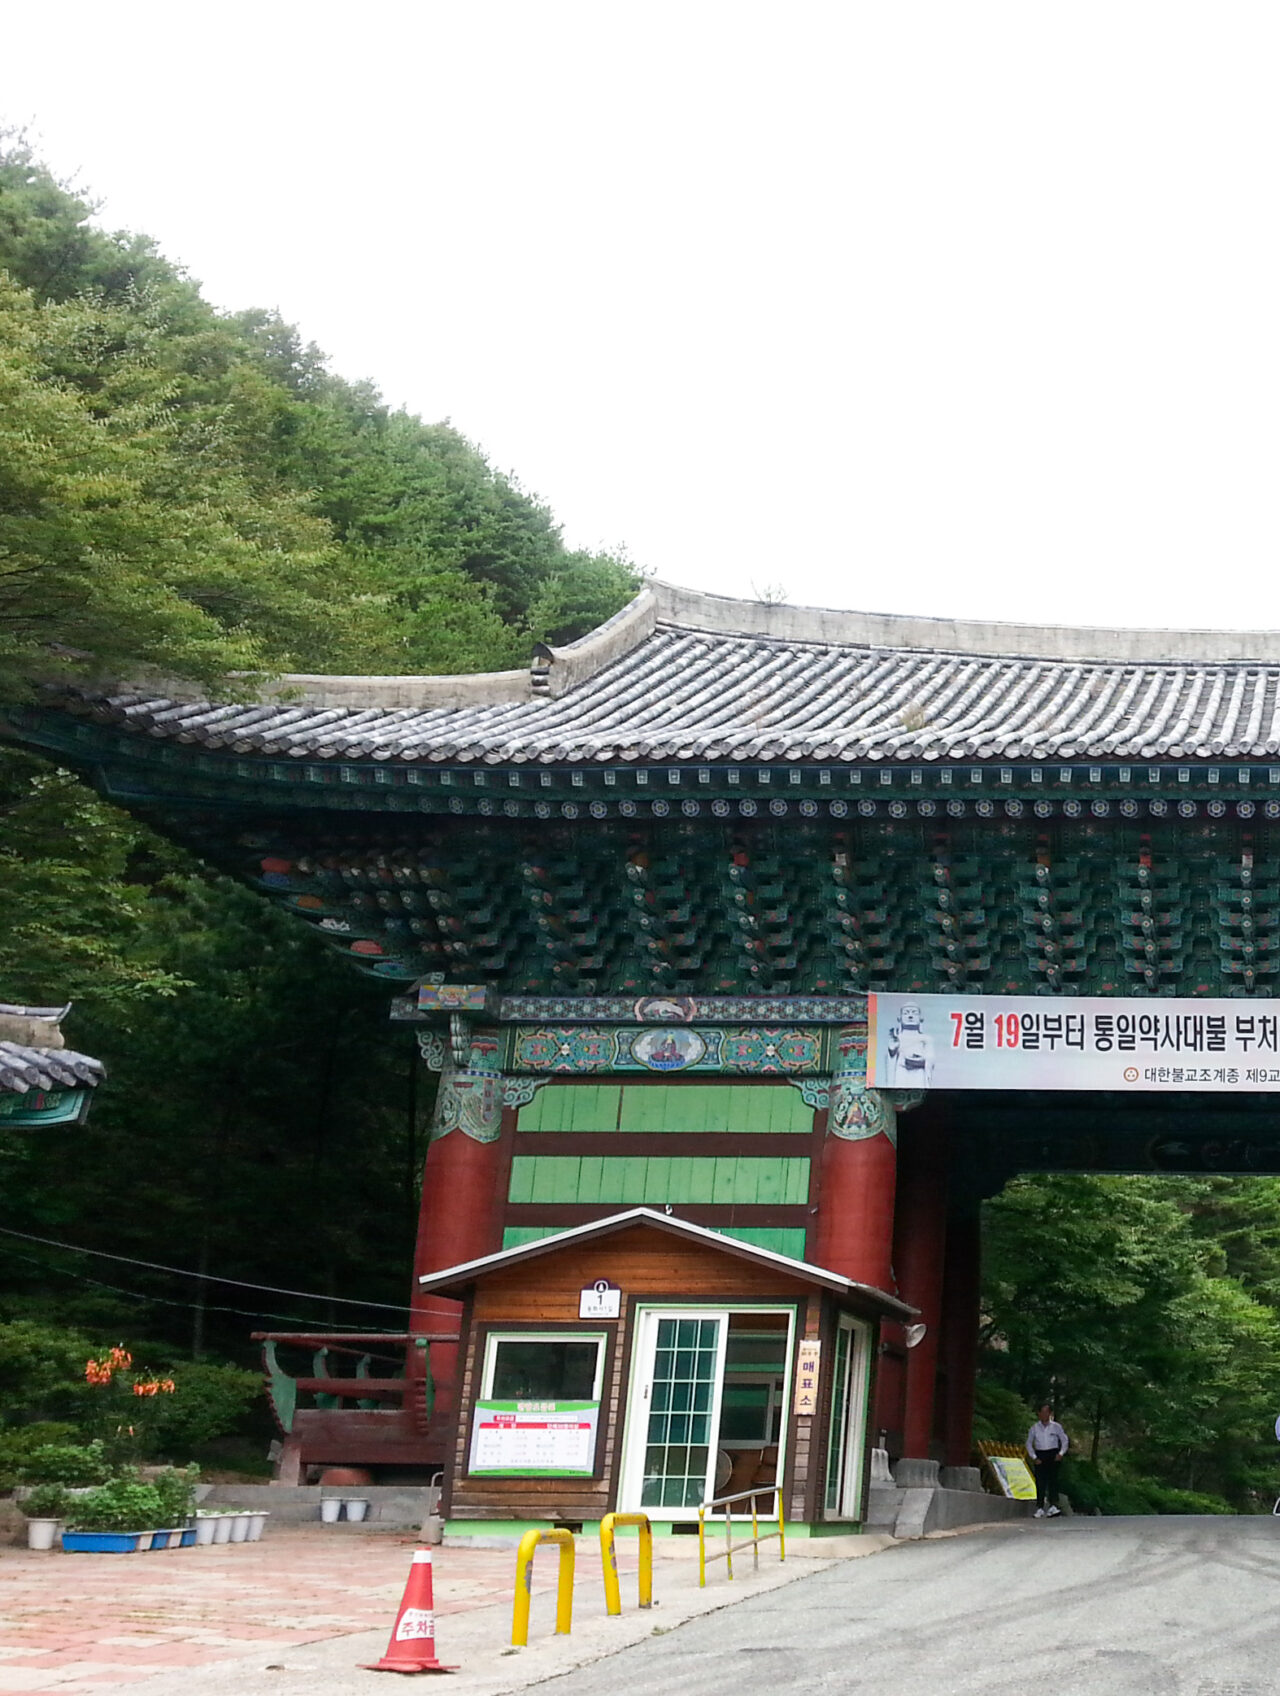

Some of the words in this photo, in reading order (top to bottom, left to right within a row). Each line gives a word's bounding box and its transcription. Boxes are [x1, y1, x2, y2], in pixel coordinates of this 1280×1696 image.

[950, 1012, 985, 1050] 7월
[994, 1013, 1085, 1051] 19일부터
[1093, 1014, 1227, 1052] 통일약사대불
[1144, 1067, 1239, 1084] 대한불교조계종
[800, 1361, 815, 1406] 매표소
